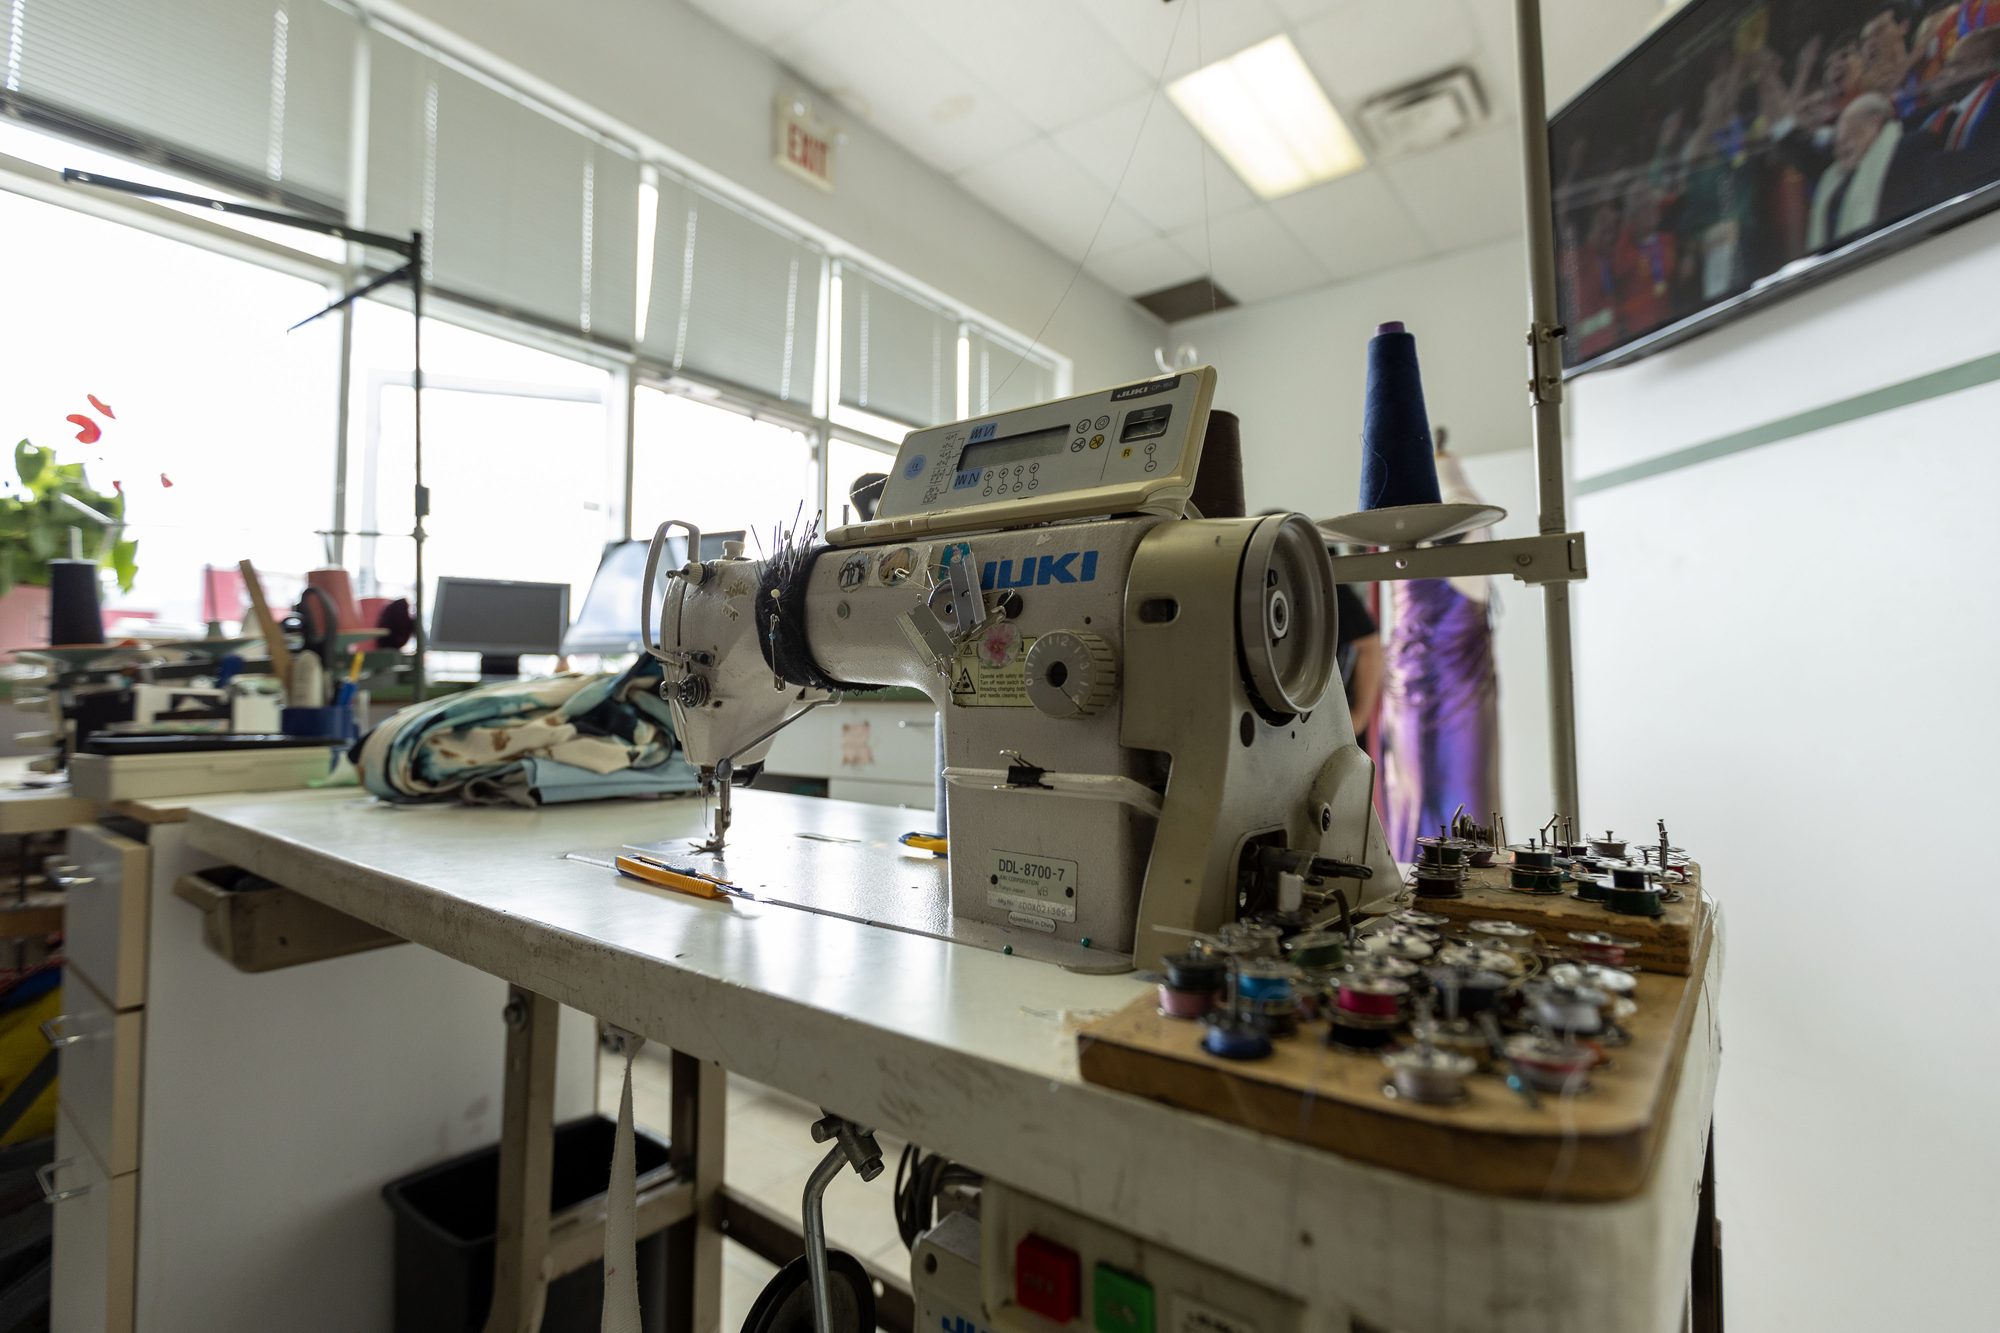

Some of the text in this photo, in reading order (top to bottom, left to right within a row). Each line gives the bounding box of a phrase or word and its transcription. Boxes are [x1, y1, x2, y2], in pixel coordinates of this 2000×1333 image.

[787, 121, 827, 178] EXIT
[1116, 386, 1149, 399] JUKI
[998, 859, 1065, 881] DDL-8700-7
[1008, 876, 1040, 886] CORPORATION
